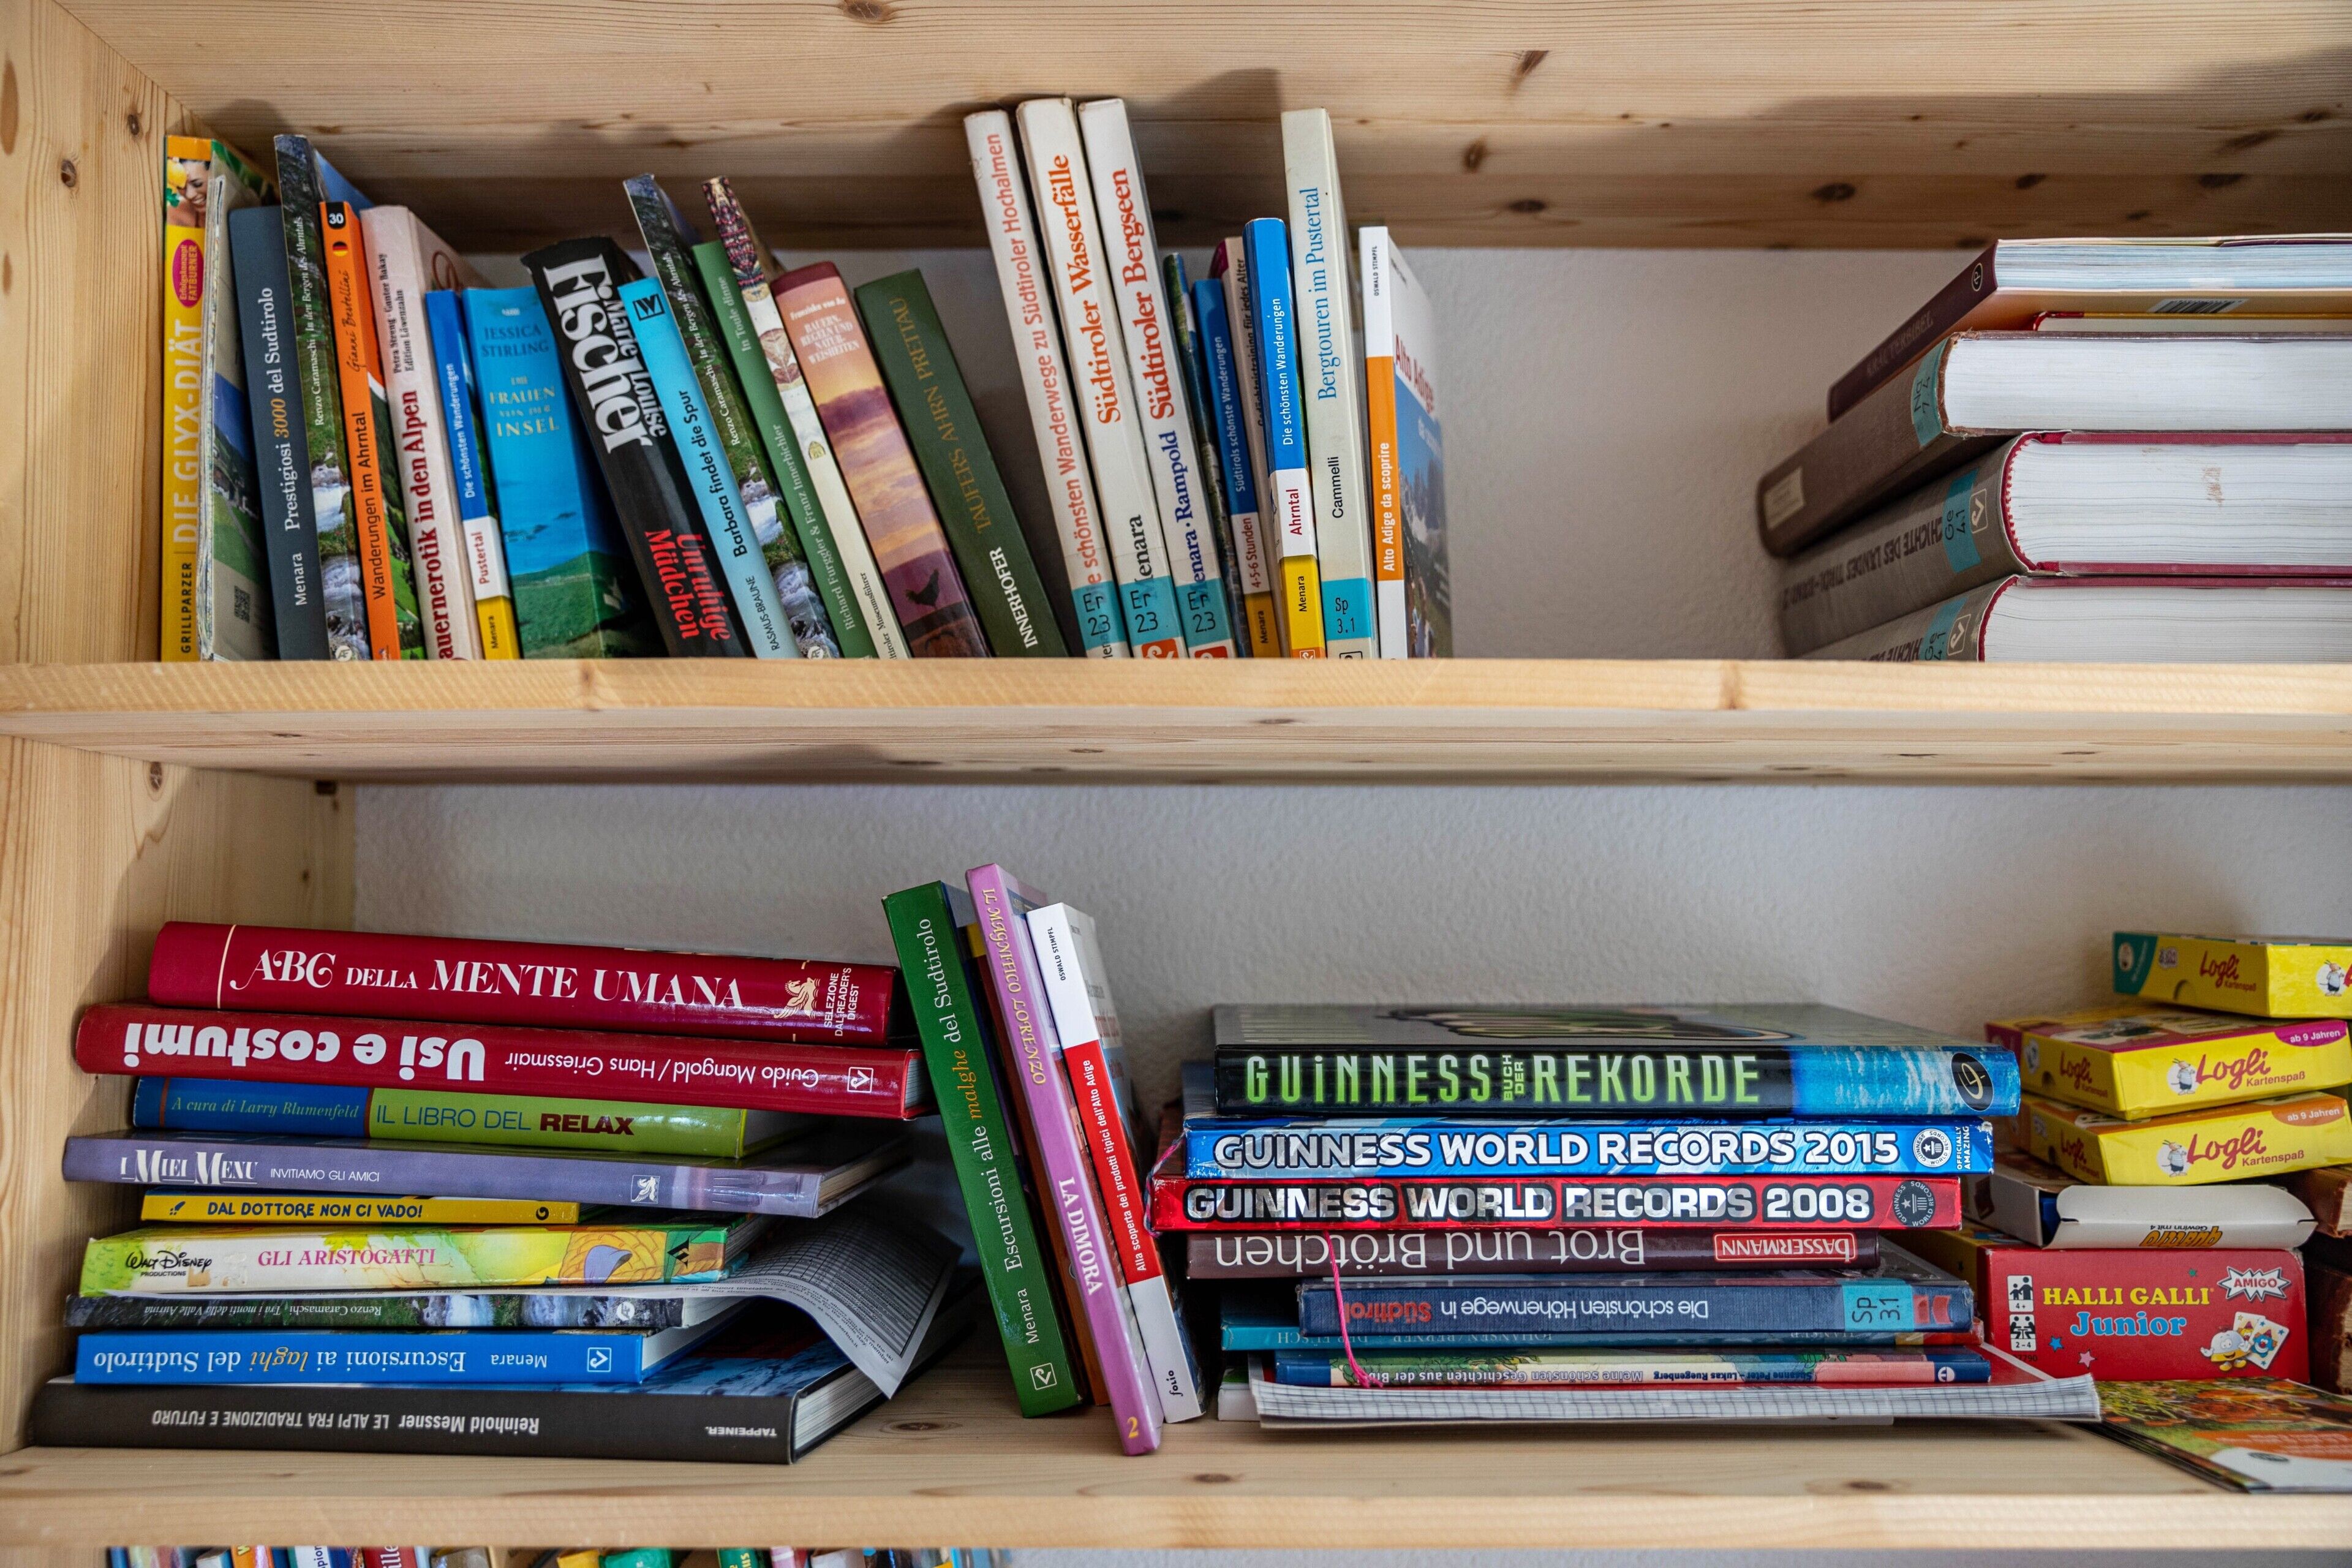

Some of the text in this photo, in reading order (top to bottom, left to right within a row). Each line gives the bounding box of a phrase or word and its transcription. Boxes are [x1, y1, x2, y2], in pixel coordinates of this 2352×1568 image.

[328, 213, 344, 225] 30
[188, 245, 198, 301] FATBURNER
[1048, 154, 1121, 424] Südtiroler Wasserfälle
[1111, 167, 1175, 420] Südtiroler Bergseen
[1299, 186, 1341, 401] Bergtouren im Pustertal
[481, 341, 549, 358] STIRLING
[543, 253, 654, 454] Fischer
[986, 132, 1099, 570] schönsten Wanderwege zu Südtiroler Hochalmen
[1272, 297, 1294, 446] Die schönsten Wanderungen
[307, 338, 323, 426] Renzo Caramaschi
[258, 287, 300, 532] Prestigiosi 3000 del Sudtirolo
[496, 417, 560, 437] INSEL
[704, 368, 741, 446] Renzo Caramaschi
[889, 297, 992, 534] TAUFERS AHRN PRETTAU
[445, 364, 476, 499] Die schönsten Wanderungen
[679, 390, 748, 558] Barbara findet die Spur
[1327, 456, 1344, 519] Cammelli
[352, 411, 386, 600] Wanderungen im Ahrntal
[401, 389, 456, 660] auernerotik in den Alpen
[773, 424, 856, 630] Richard Furggler & Franz Innerbichler
[1285, 488, 1303, 536] Ahrntal
[1379, 442, 1396, 572] Alto Adige da scoprire
[1944, 509, 1954, 541] Ge
[295, 552, 307, 606] Menara
[470, 531, 489, 584] Pustertal
[644, 529, 701, 639] Mädchen
[676, 533, 731, 641] Unruhige
[859, 572, 887, 631] Museumsführer
[989, 546, 1038, 649] INNERHOFER
[1083, 592, 1104, 612] Er
[1298, 576, 1308, 612] Menara
[181, 561, 192, 654] GRILLPARZER
[745, 575, 781, 650] RASMUS-BRAUNE
[1256, 610, 1269, 644] Menara
[488, 616, 499, 650] Menara
[229, 949, 745, 1010] ABC DELLA MENTE UMANA
[2199, 950, 2240, 982] Logli
[824, 971, 840, 1029] SELEZIONE
[846, 982, 861, 1021] DIGEST
[123, 1022, 485, 1082] Usi e costumi
[2290, 1035, 2302, 1044] ab
[2310, 1028, 2341, 1041] Jahren
[505, 1050, 820, 1089] Guido Mangold Hans Griessmair
[1502, 1054, 1513, 1101] BUCH
[1514, 1060, 1524, 1095] DER
[1533, 1054, 1759, 1103] REKORDE
[2059, 1051, 2092, 1091] Logli
[2196, 1048, 2271, 1090] Logli
[2245, 1070, 2305, 1087] Kartenspaß
[916, 918, 1023, 1273] Escursioni alle malghe del Sudtirolo
[376, 1104, 635, 1136] IL LIBRO DEL RELAX
[1214, 1130, 1899, 1167] GUINNESS WORLD RECORDS 2015
[1954, 1126, 1963, 1170] OFFICIALLY
[1962, 1126, 1972, 1170] AMAZING
[2186, 1126, 2266, 1170] Logli
[2241, 1149, 2305, 1167] Kartenspaß
[207, 1201, 423, 1218] DAL DOTTORE NON CI VADO!
[1187, 1187, 1871, 1219] GUINNESS WORLD RECORDS 2008
[1893, 1184, 1907, 1224] GUINNESS
[257, 1248, 436, 1266] GLI ARISTOGATTI
[1058, 1176, 1103, 1295] LA DIMORA
[1215, 1227, 1646, 1273] Brot und Brötchen
[2043, 1287, 2211, 1305] HALLI GALLI
[2234, 1276, 2278, 1288] AMIGO
[288, 1304, 382, 1317] Renzo Caramaschi
[1018, 1288, 1040, 1344] Menara
[1344, 1298, 1709, 1323] Die schönsten Höhenwege in Südtirol
[1879, 1297, 1901, 1321] 3.1
[2070, 1311, 2187, 1336] Junior
[93, 1346, 466, 1375] Escursioni ai laghi del Sudtirolo
[491, 1354, 548, 1369] Menara
[1166, 1370, 1183, 1397] folio
[152, 1410, 388, 1428] LE ALPI FRA TRADIZIONE E FUTURO
[399, 1414, 540, 1434] Reinhold Messner
[1127, 1417, 1139, 1439] 2
